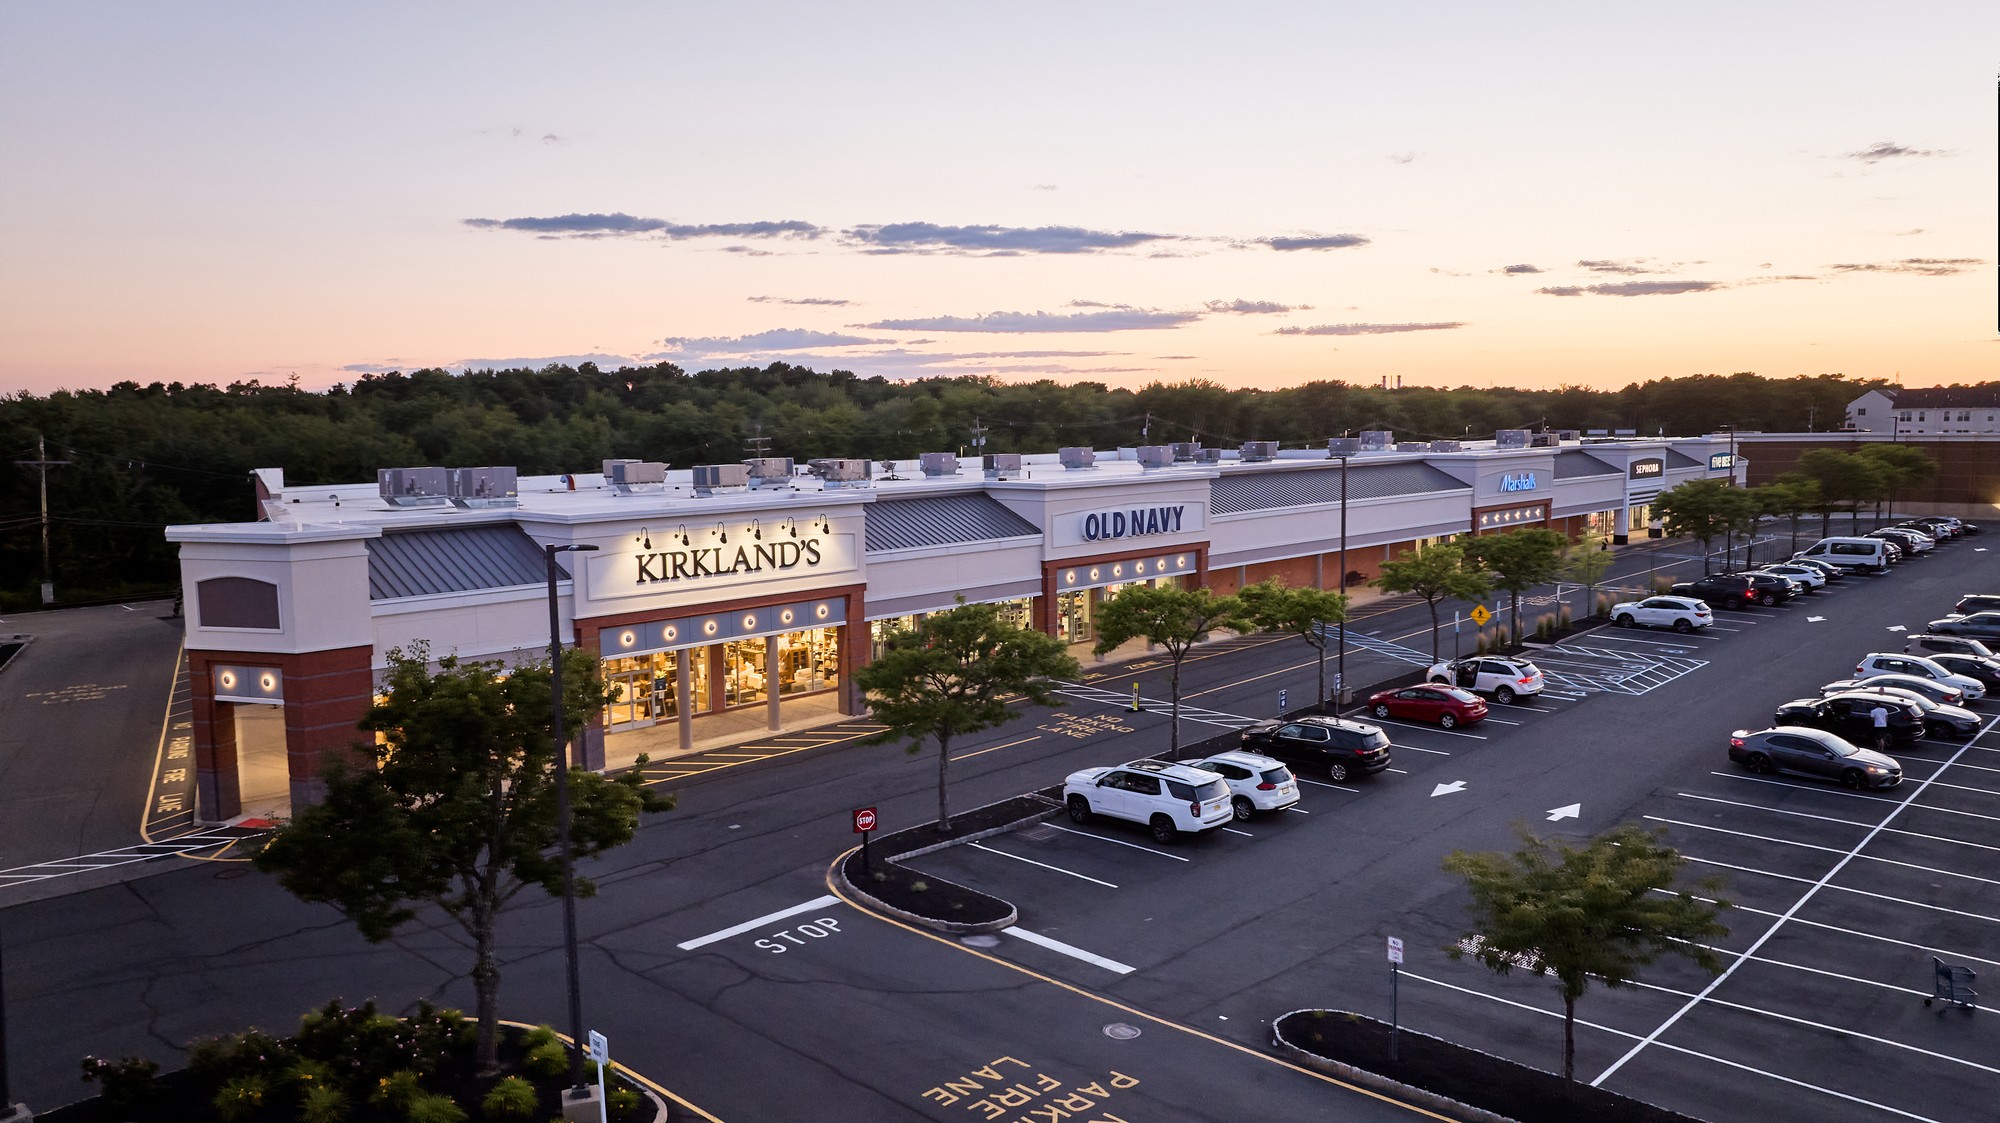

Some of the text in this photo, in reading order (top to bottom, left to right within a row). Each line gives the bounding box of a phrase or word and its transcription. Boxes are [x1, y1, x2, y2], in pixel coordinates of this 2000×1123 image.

[1635, 463, 1659, 474] SEPHORA
[1500, 472, 1536, 492] Marshalls
[1084, 505, 1184, 541] OLD NAVY
[635, 538, 821, 583] KIRKLAND'S
[1051, 712, 1135, 733] PARKING
[1056, 720, 1104, 734] FIRE
[1094, 714, 1124, 723] NO
[1036, 724, 1092, 739] LANE
[859, 816, 873, 825] STOP
[754, 917, 842, 954] STOP
[921, 1056, 1031, 1107] LANE
[967, 1073, 1062, 1120] FIRE
[1012, 1070, 1140, 1123] PARK
